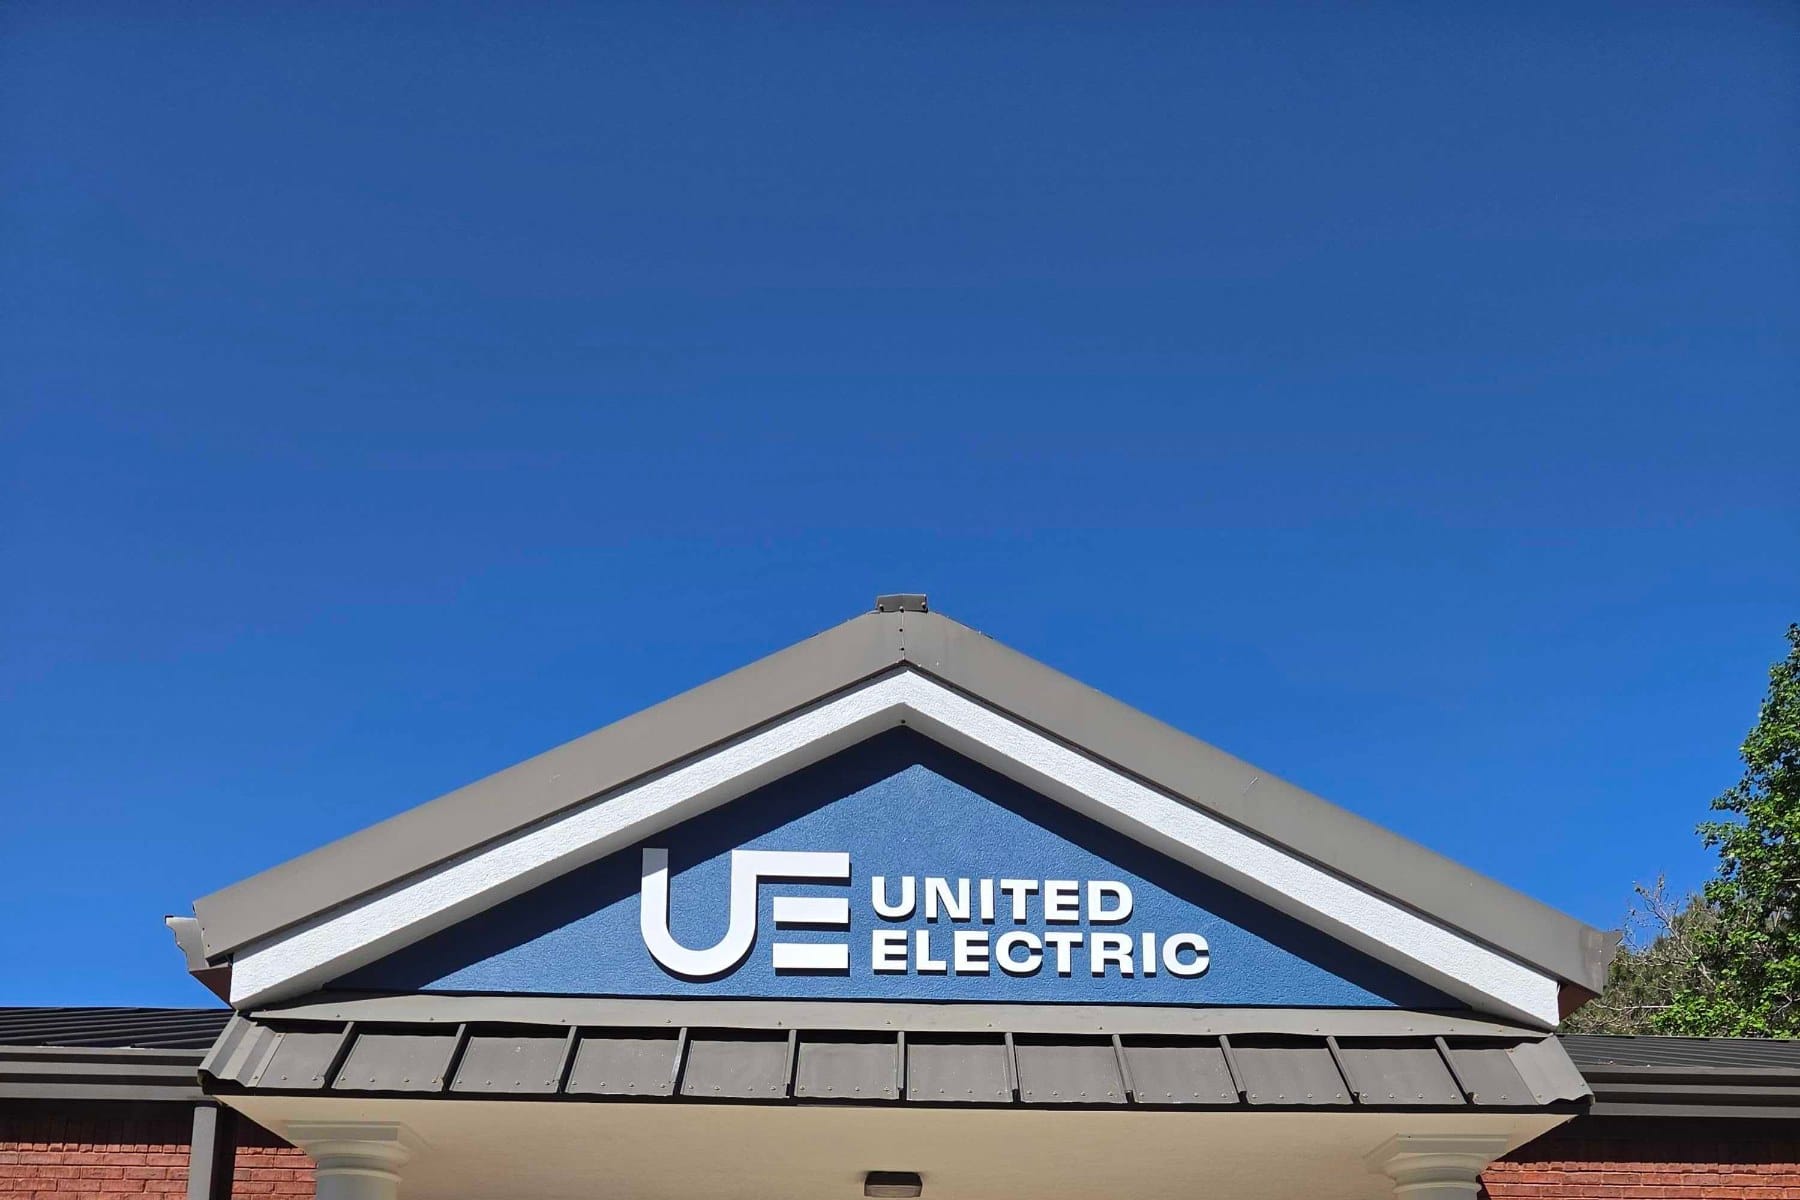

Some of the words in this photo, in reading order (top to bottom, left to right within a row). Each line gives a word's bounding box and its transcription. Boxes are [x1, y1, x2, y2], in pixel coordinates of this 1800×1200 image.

[640, 847, 850, 976] UE
[871, 875, 1133, 922] UNITED
[871, 929, 1210, 976] ELECTRIC
